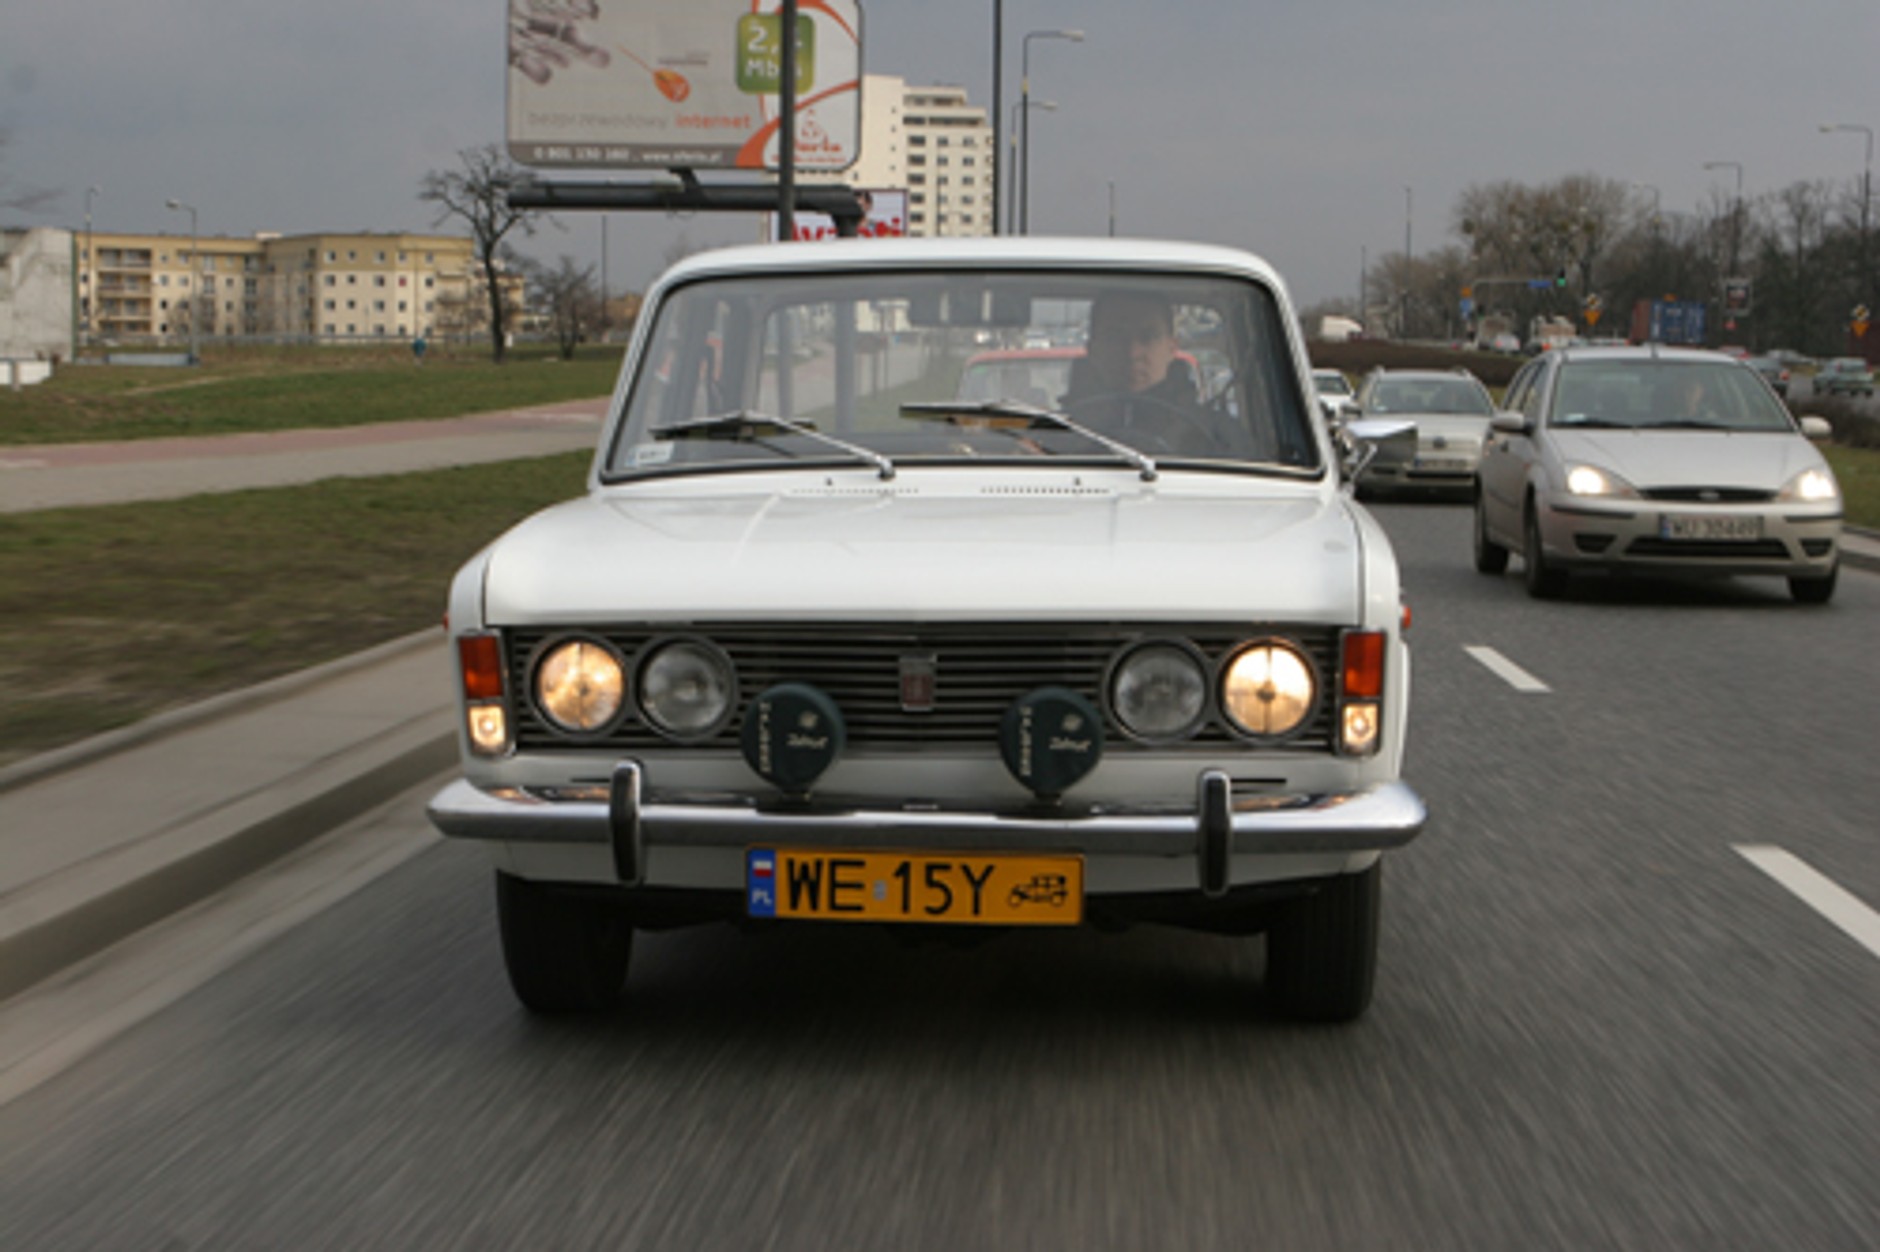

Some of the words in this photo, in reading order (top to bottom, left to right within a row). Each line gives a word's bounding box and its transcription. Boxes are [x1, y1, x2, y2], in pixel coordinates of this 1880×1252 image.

[675, 113, 751, 129] internet
[786, 858, 866, 912] WE
[894, 861, 996, 916] 15Y
[752, 888, 772, 905] PL
